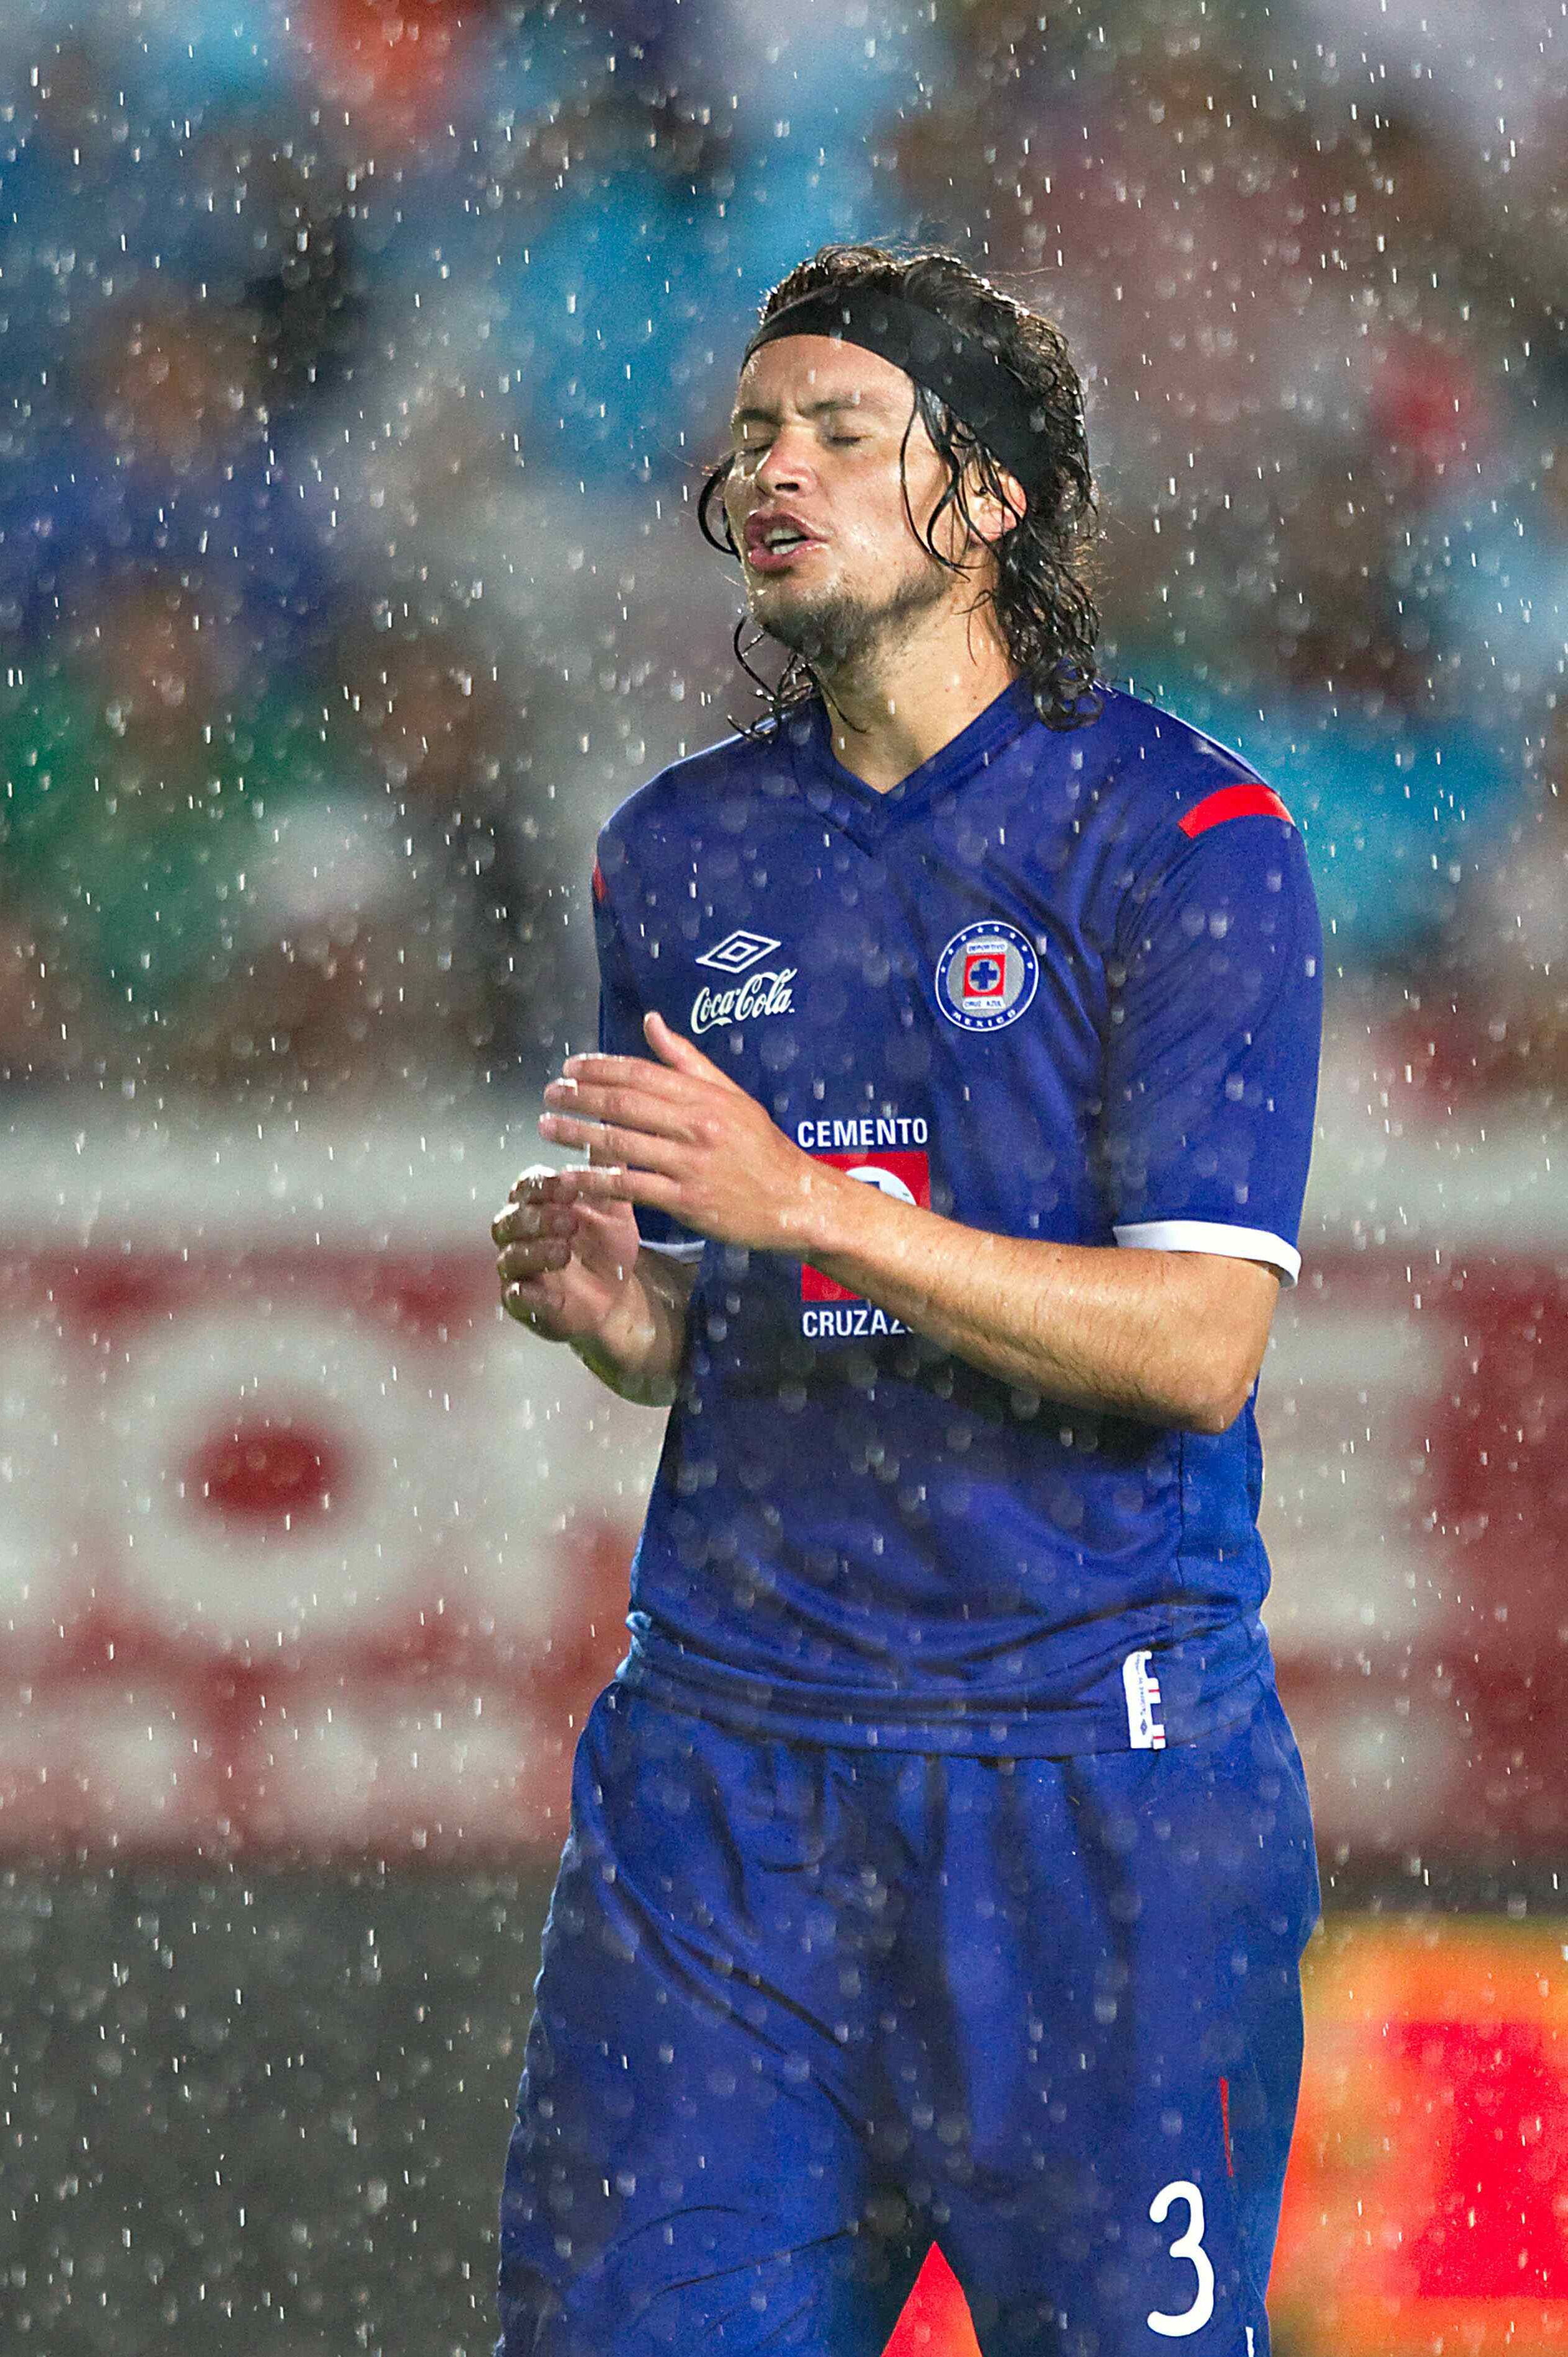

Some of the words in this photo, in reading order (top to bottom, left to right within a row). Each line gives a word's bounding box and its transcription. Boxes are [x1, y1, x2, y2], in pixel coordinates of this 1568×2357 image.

[953, 1010, 1016, 1027] MEXICO
[797, 1118, 928, 1148] CEMENTO
[1147, 2180, 1215, 2337] 3
